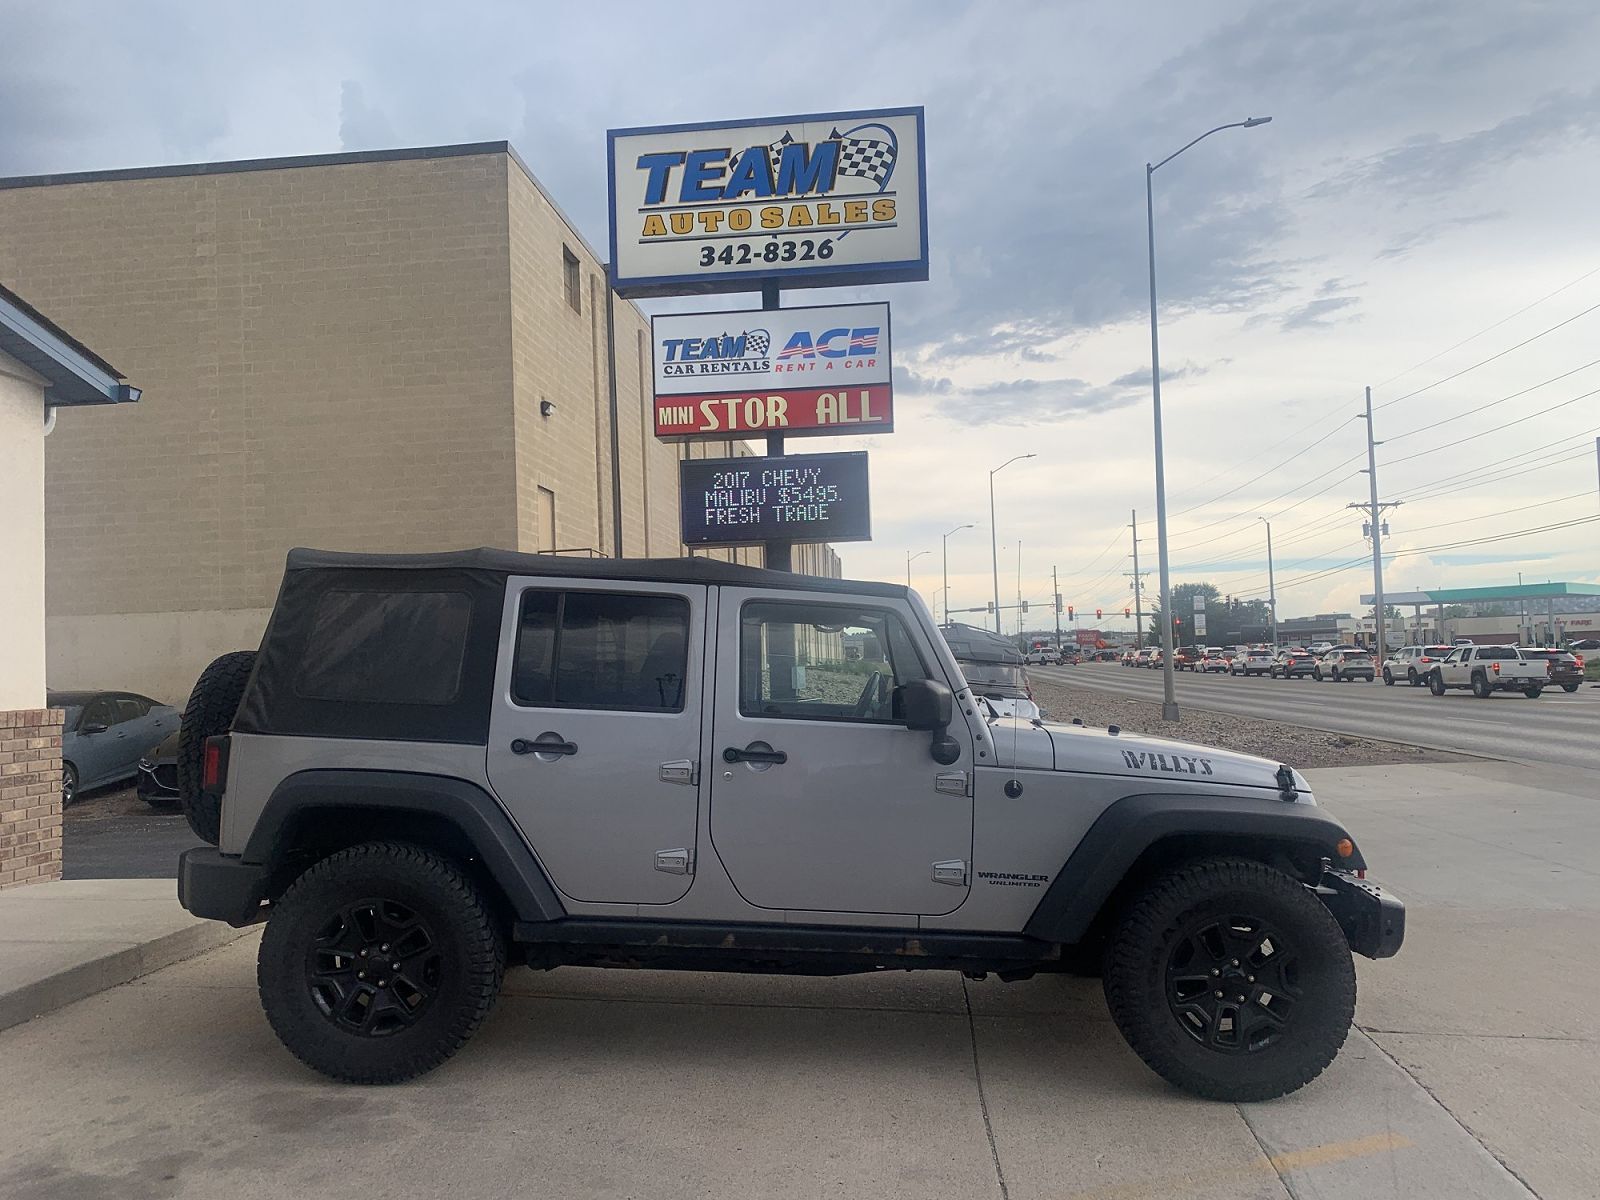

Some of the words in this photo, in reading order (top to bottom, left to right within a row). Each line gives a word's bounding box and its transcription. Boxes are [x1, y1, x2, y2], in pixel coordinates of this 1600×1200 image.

[636, 140, 842, 205] TEAM
[642, 208, 751, 236] AUTO
[761, 199, 897, 229] SALES
[700, 239, 834, 267] 342-8326
[662, 336, 747, 362] TEAM
[776, 327, 880, 361] ACE
[663, 363, 695, 375] CAR
[700, 361, 770, 373] RENTALS
[775, 362, 816, 373] RENT
[826, 361, 833, 370] A
[844, 358, 877, 369] CAR
[658, 406, 694, 426] MINI
[700, 396, 789, 431] STOR
[815, 390, 882, 425] ALL
[713, 471, 750, 489] 2017
[762, 468, 821, 487] CHEVY
[705, 488, 766, 507] MALIBU
[705, 507, 760, 526] FRESH
[772, 504, 829, 522] TRADE
[1120, 749, 1213, 776] WILLYS
[977, 871, 1049, 883] WRANGLER
[988, 880, 1041, 888] UNLIMITED
